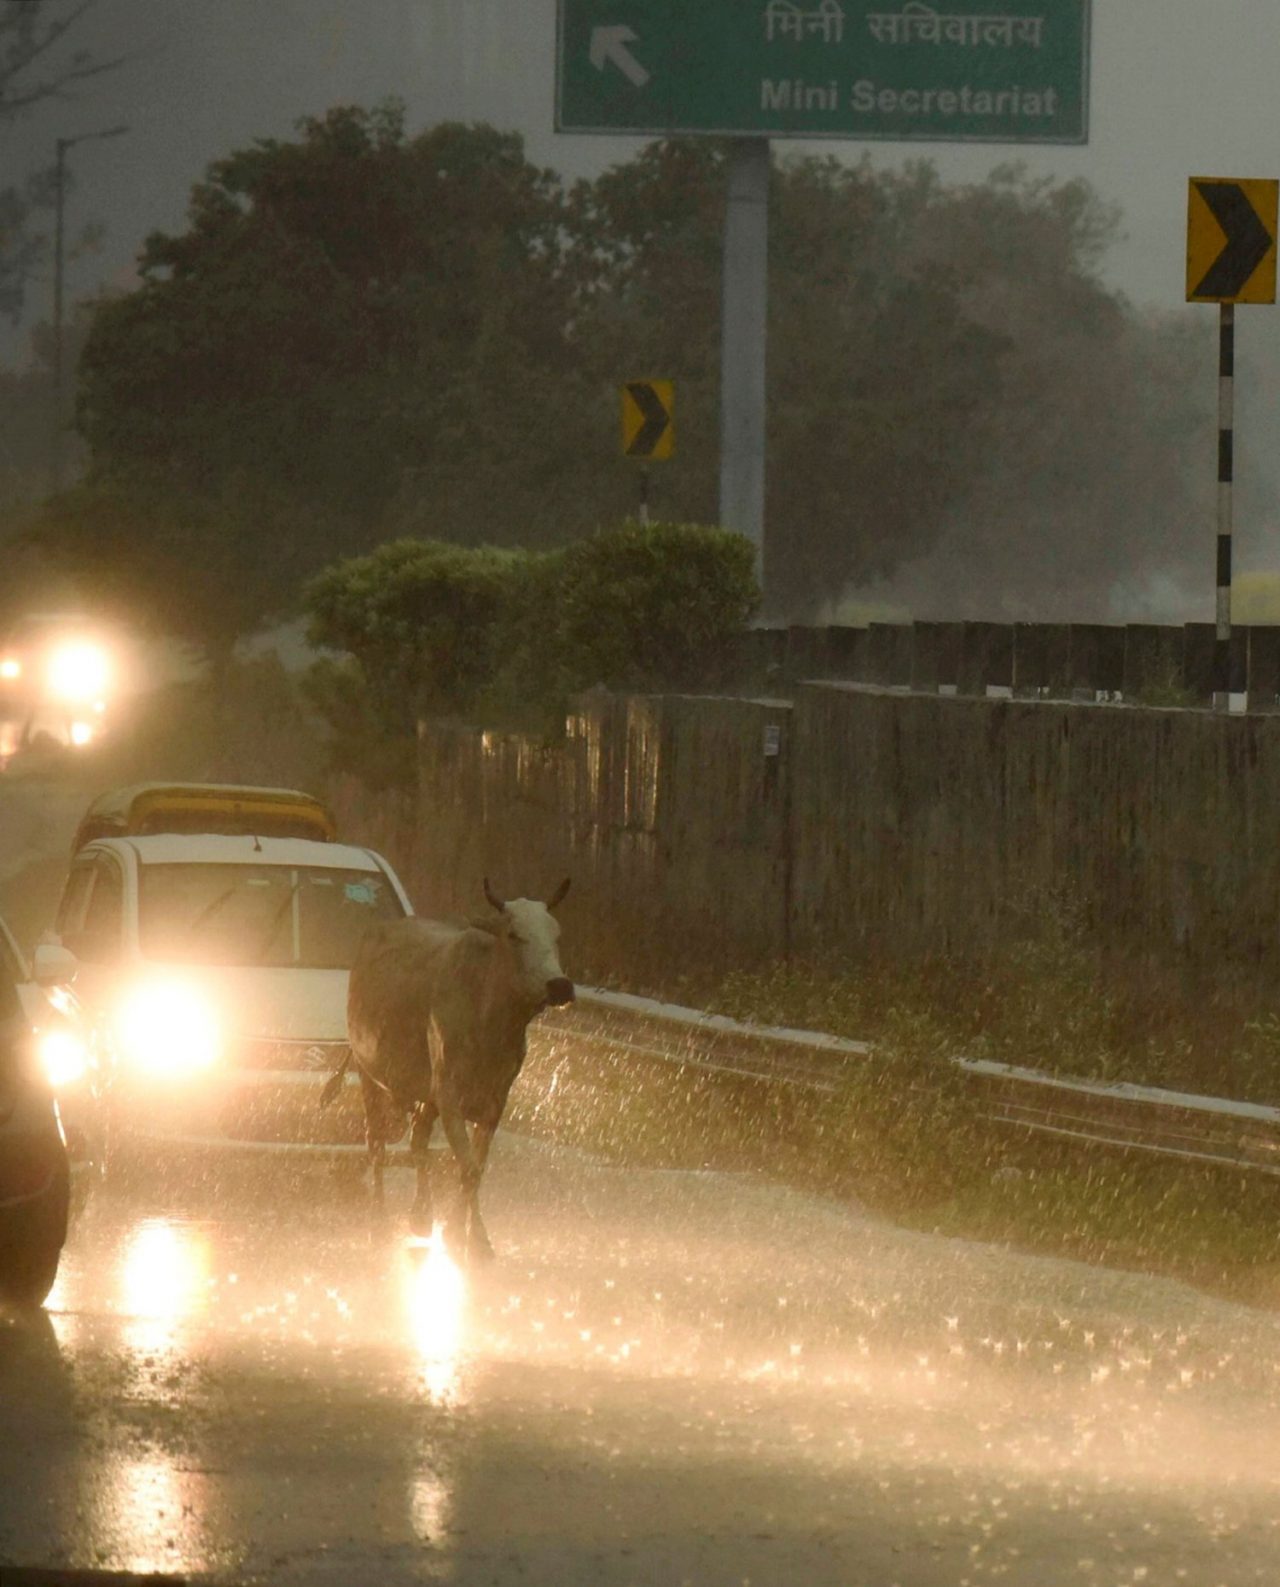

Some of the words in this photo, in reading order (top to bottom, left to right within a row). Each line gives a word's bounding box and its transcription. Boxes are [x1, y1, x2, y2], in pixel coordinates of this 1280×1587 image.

[764, 0, 845, 42] मिनी
[866, 0, 1044, 48] सचिवालय
[760, 78, 839, 112] Mini
[851, 79, 1058, 117] Secretariat
